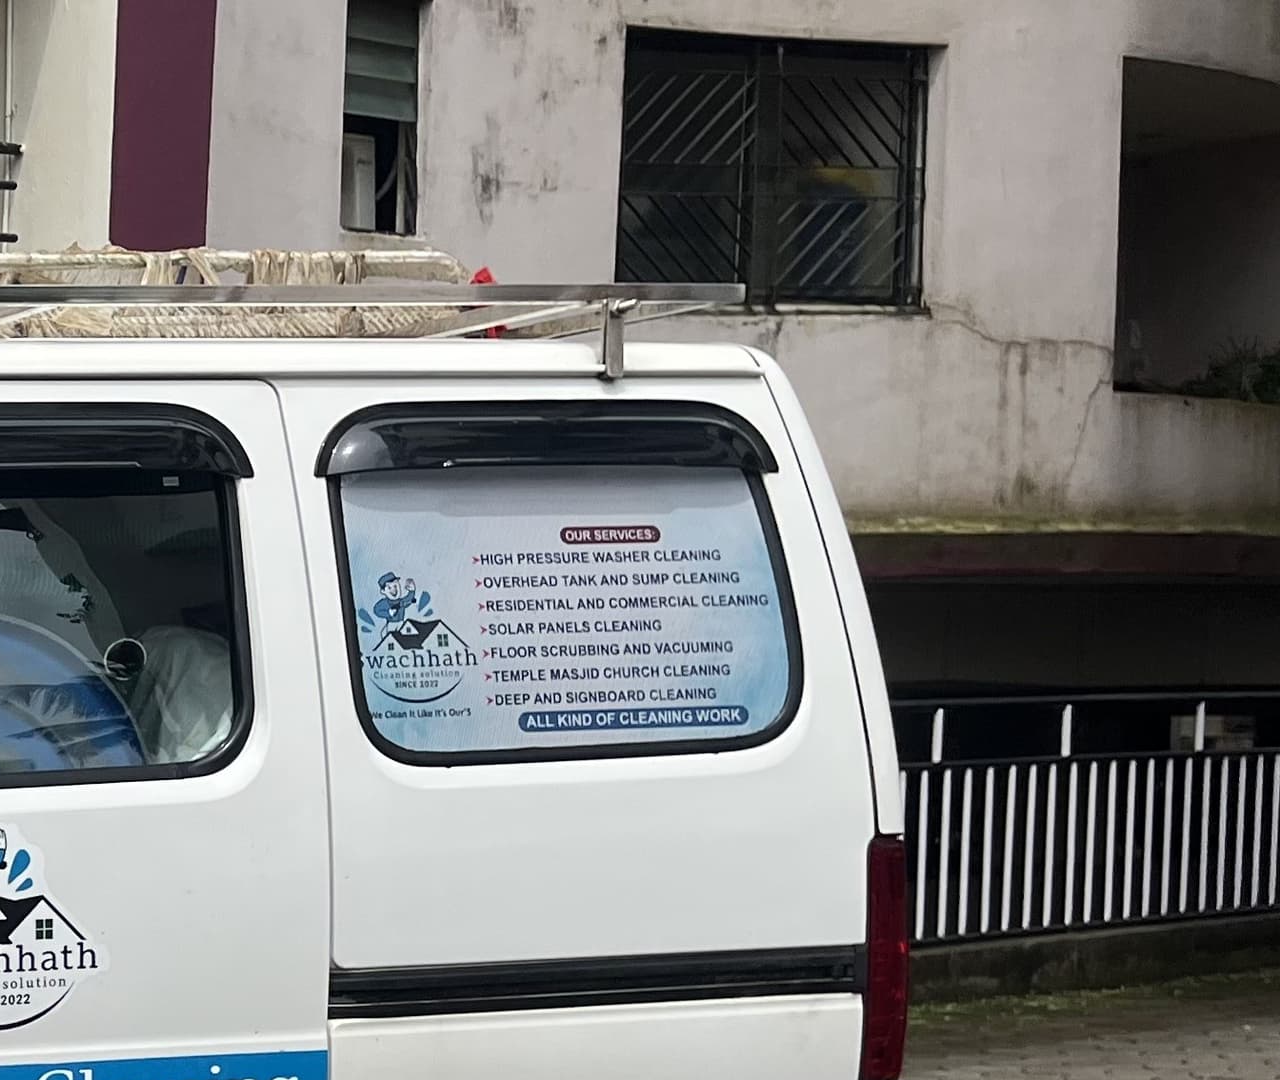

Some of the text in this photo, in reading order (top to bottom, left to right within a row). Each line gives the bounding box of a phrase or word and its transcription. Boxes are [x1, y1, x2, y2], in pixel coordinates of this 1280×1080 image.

[565, 529, 656, 541] OUR SERVICES:
[481, 549, 721, 566] HIGH PRESSURE WASHER CLEANING
[483, 571, 740, 589] OVERHEAD TANK AND SUMP CLEANING
[486, 594, 769, 612] RESIDENTIAL AND COMMERCIAL CLEANING
[488, 619, 662, 635] SOLAR PANELS CLEANING
[360, 648, 478, 669] wachhath
[491, 641, 733, 659] FLOOR SCRUBBING AND VACUUMING
[493, 664, 730, 682] TEMPLE MASJID CHURCH CLEANING
[495, 688, 717, 706] DEEP AND SIGNBOARD CLEANING
[526, 707, 741, 729] ALL KIND OF CLEANING WORK
[2, 977, 67, 990] solution
[0, 994, 31, 1006] 2022
